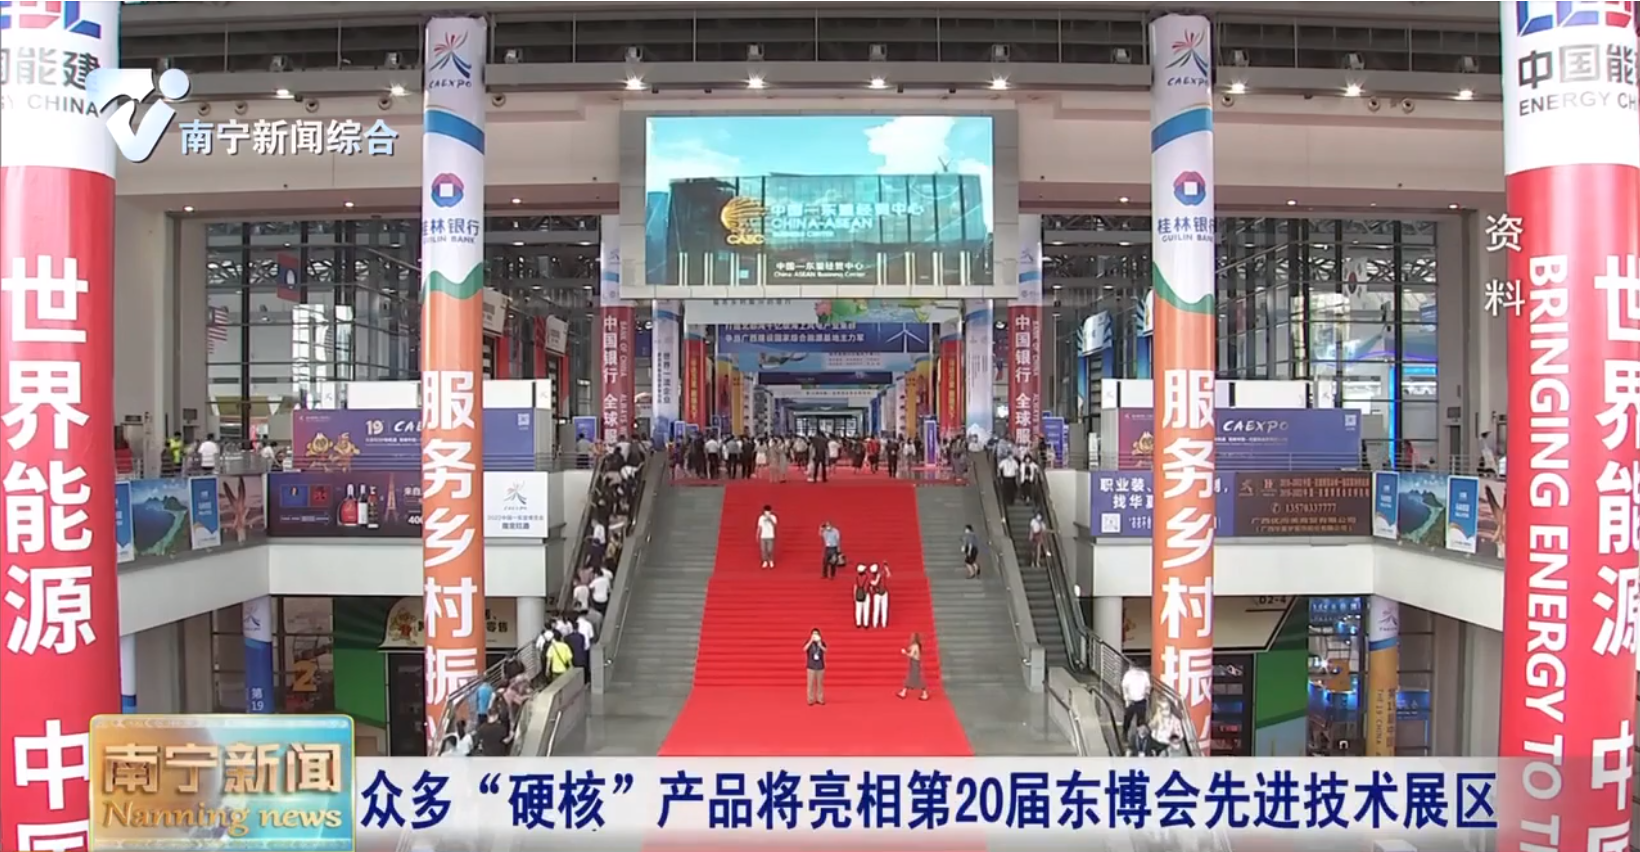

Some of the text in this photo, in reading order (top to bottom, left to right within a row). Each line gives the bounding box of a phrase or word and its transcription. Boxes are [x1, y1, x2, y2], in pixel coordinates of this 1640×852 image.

[0, 46, 101, 90] 能建
[428, 79, 472, 89] CAEXPO
[1518, 43, 1640, 90] 中国能
[27, 94, 99, 118] CHINA
[1519, 90, 1611, 117] ENERGY
[603, 315, 619, 384] 中国银行
[1015, 314, 1032, 384] 中国银行
[1527, 254, 1570, 509] BRINGING
[2, 255, 96, 656] 世界能源
[365, 419, 384, 436] 19
[1222, 419, 1289, 434] CAEXPO
[422, 370, 477, 754] 服务乡村振
[1160, 369, 1214, 754] 服务乡村振
[1524, 523, 1570, 723] ENERGY
[1522, 734, 1564, 800] TO
